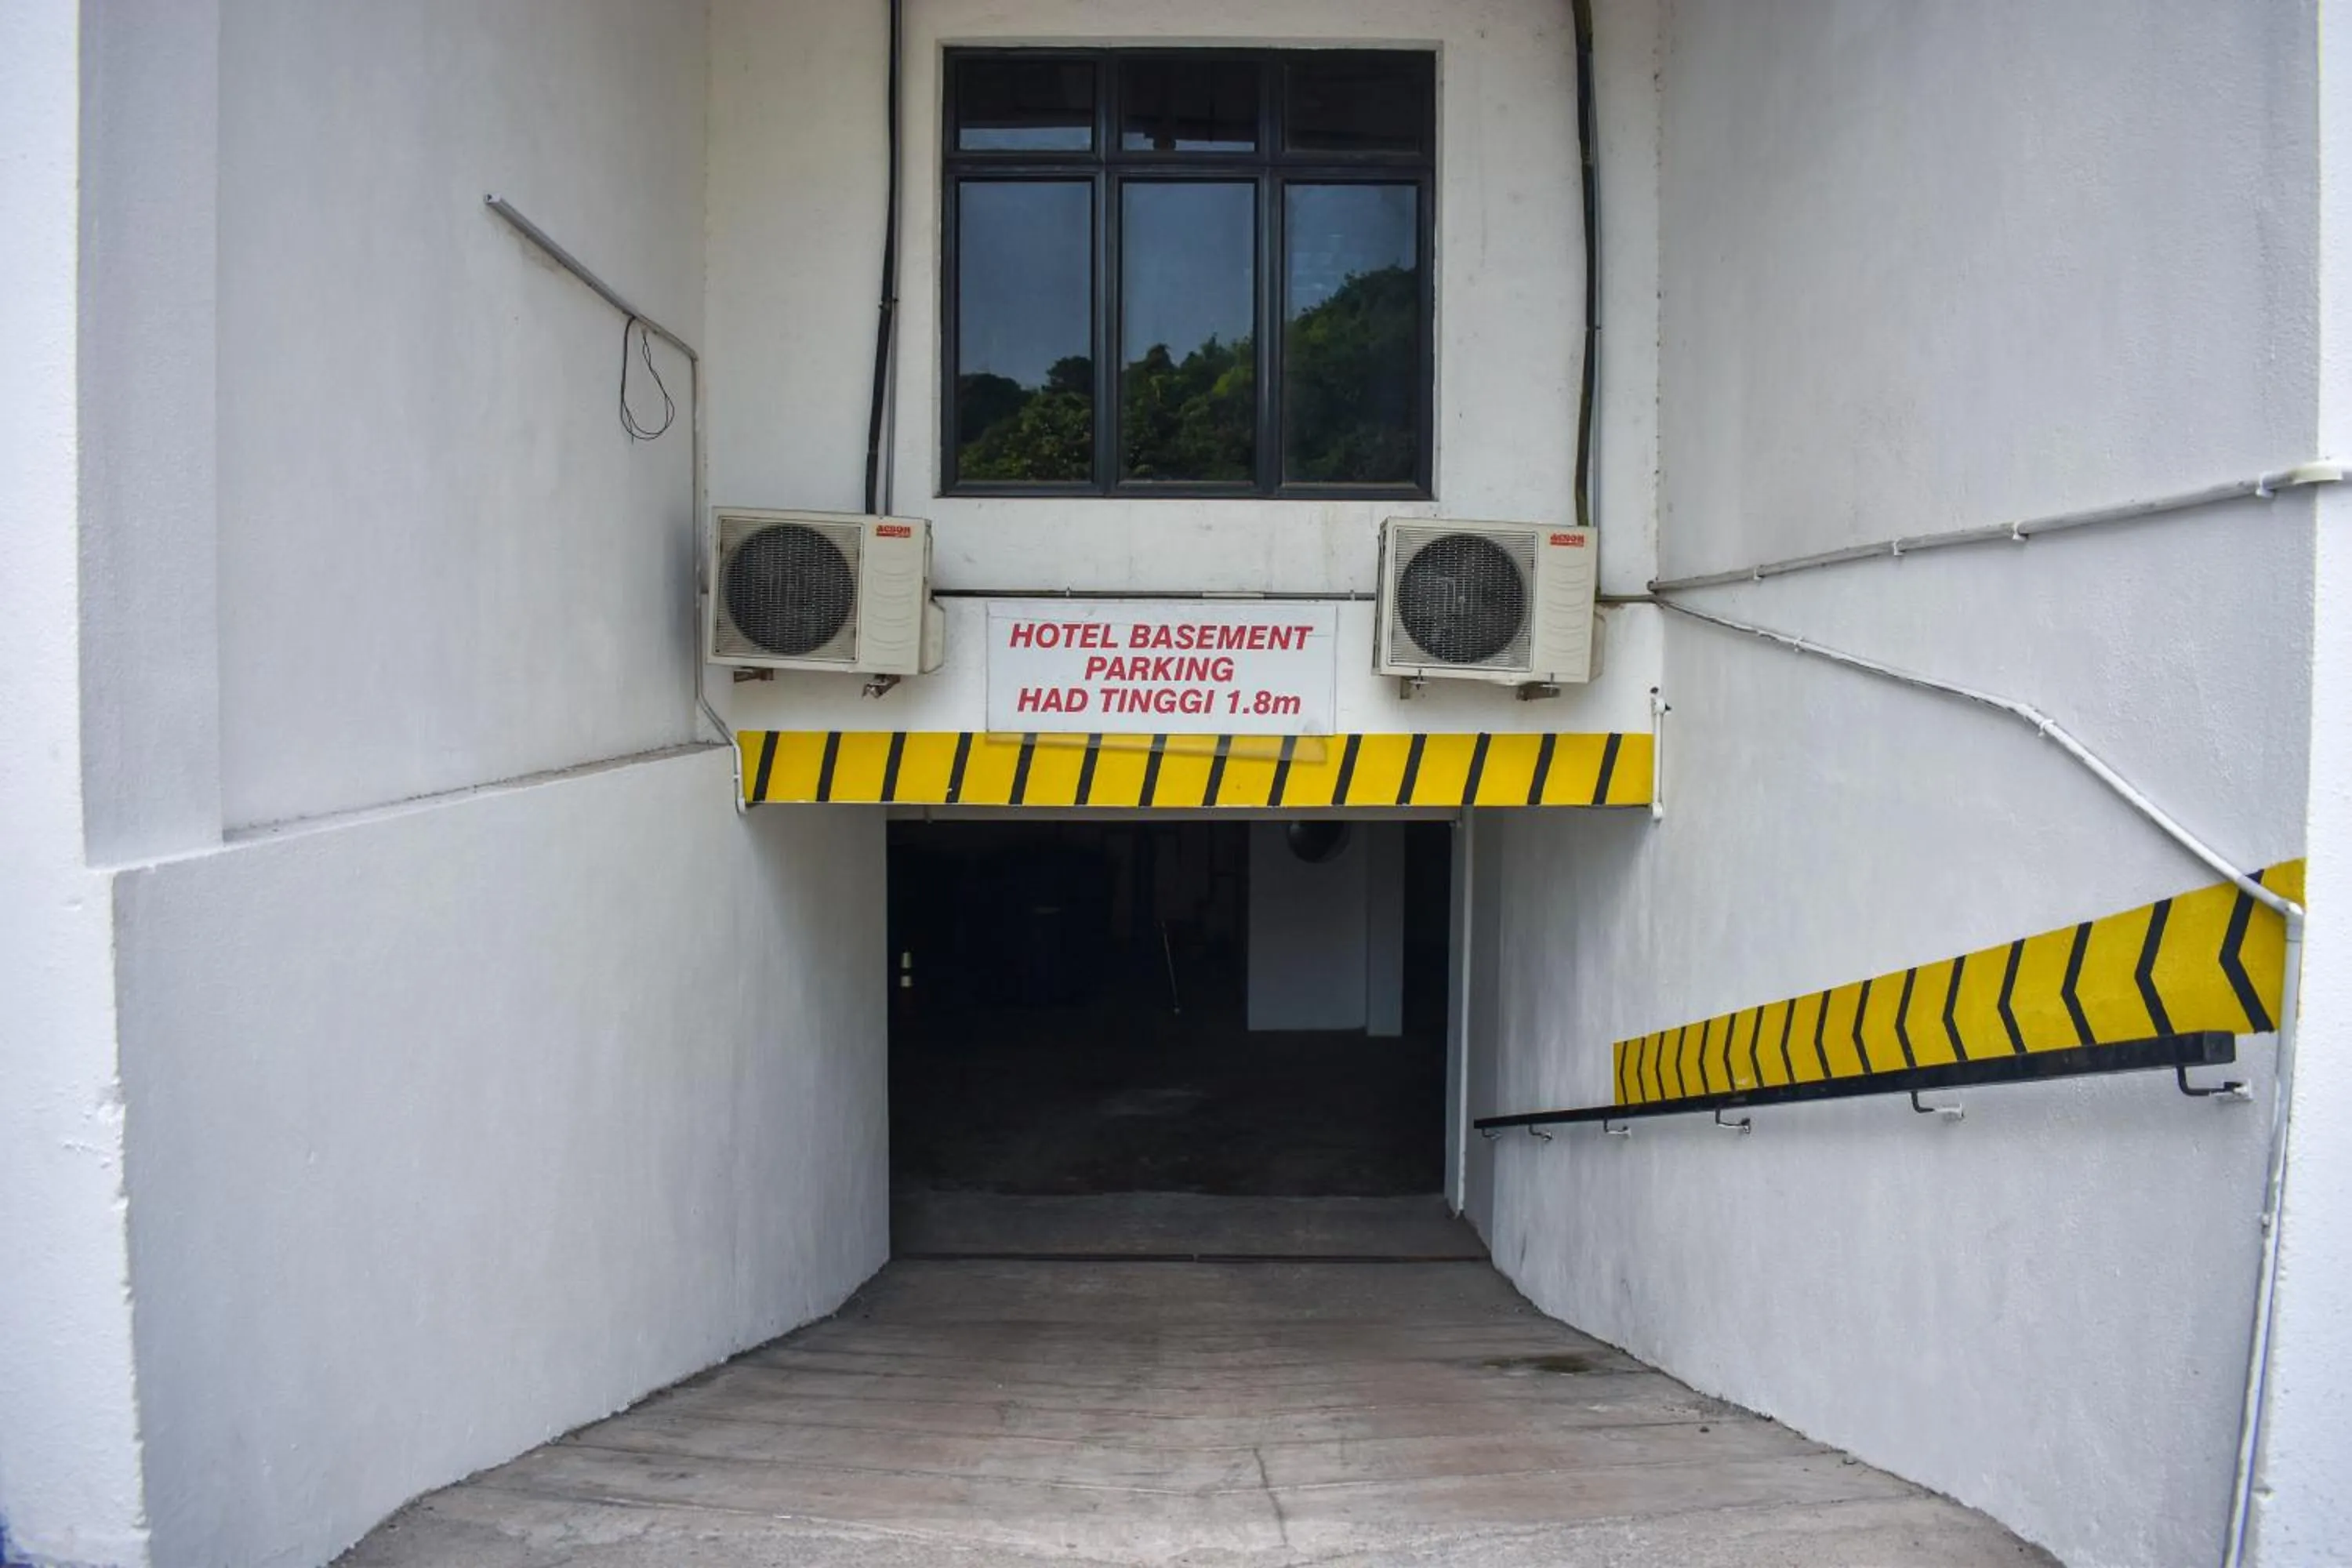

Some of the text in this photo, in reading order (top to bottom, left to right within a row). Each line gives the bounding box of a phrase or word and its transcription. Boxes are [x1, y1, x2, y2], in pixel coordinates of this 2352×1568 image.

[1009, 622, 1312, 651] HOTEL BASEMENT
[1084, 656, 1234, 682] PARKING
[1018, 687, 1301, 715] HAD TINGGI 1.8m
